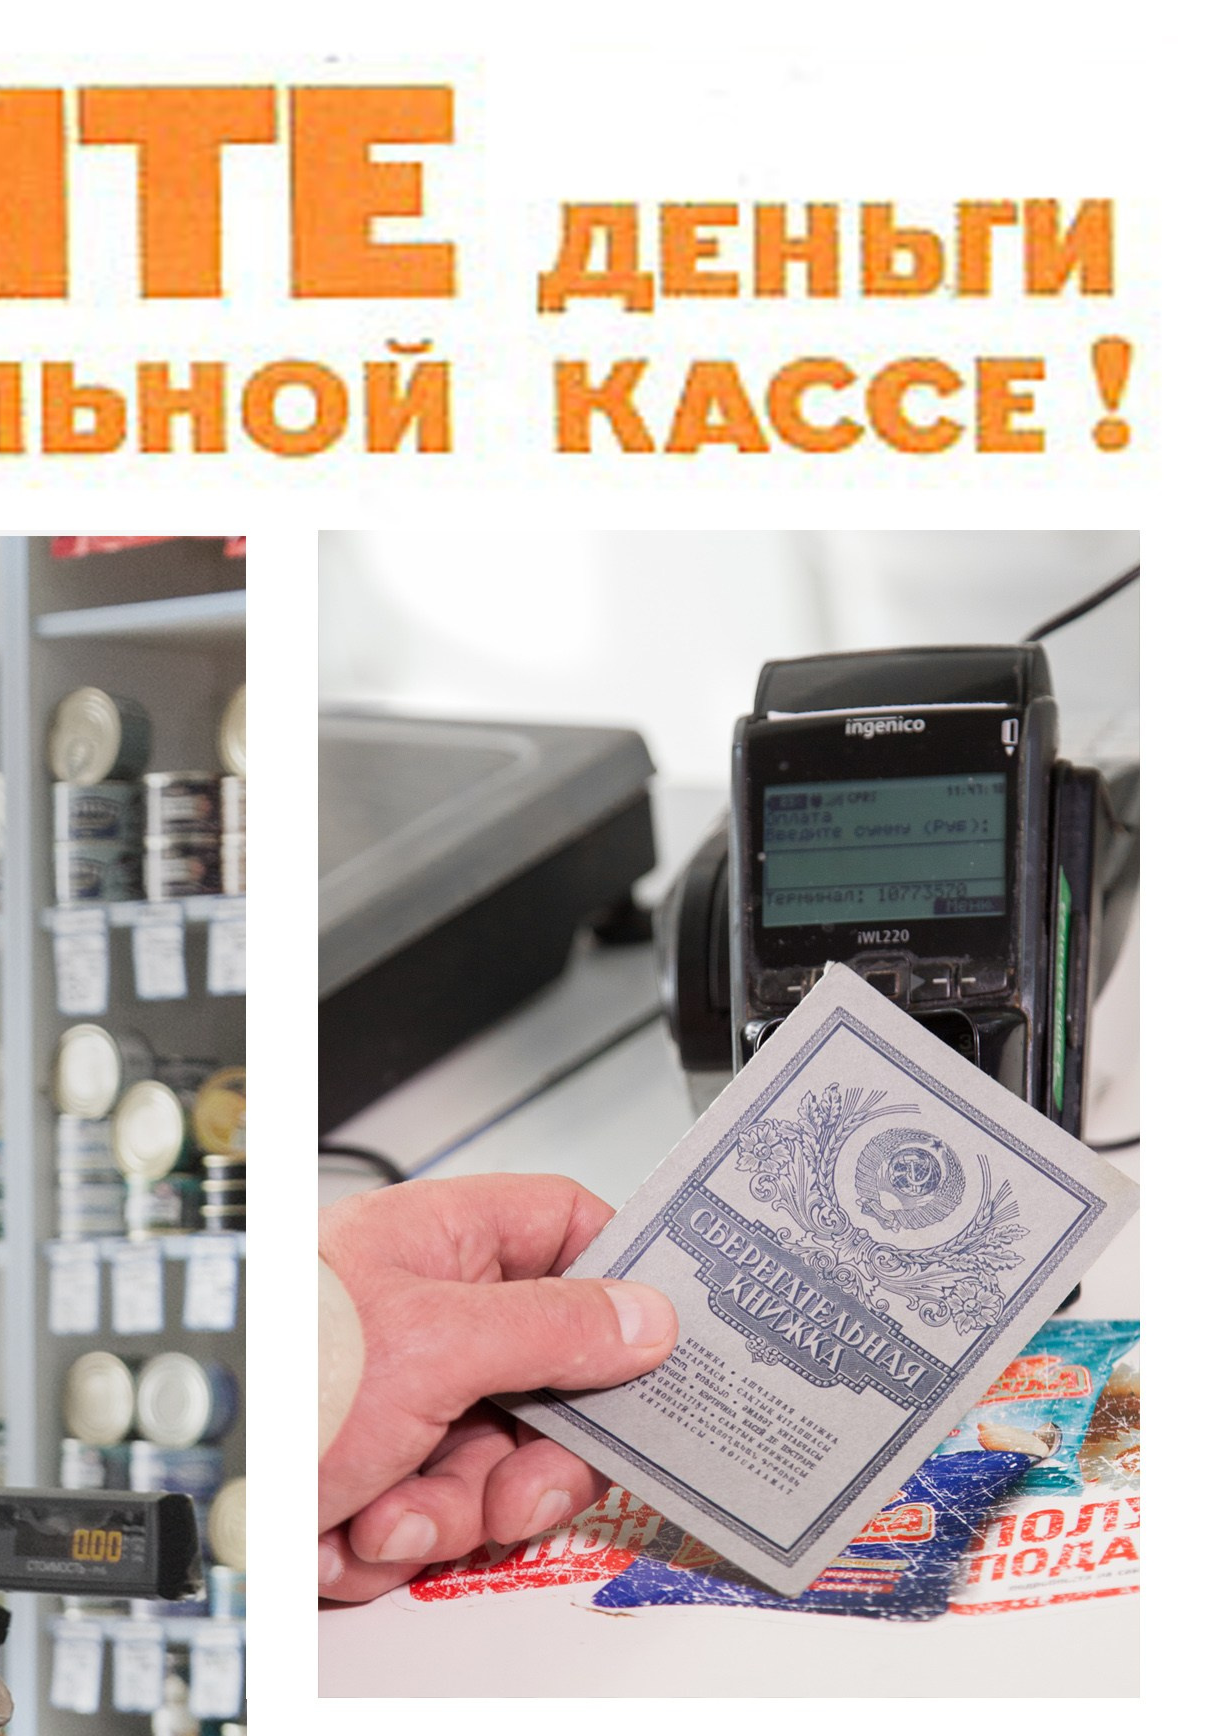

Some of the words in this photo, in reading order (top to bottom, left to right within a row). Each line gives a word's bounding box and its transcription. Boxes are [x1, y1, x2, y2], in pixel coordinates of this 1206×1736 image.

[844, 717, 926, 739] ingenico
[857, 929, 910, 945] iWL220
[688, 1206, 927, 1391] СБЕРЕГАТЕЛЬНАЯ
[720, 1271, 846, 1374] КНИЖКА
[684, 1336, 726, 1368] КНИЖКА
[739, 1374, 796, 1416] АШЧАДНАЯ
